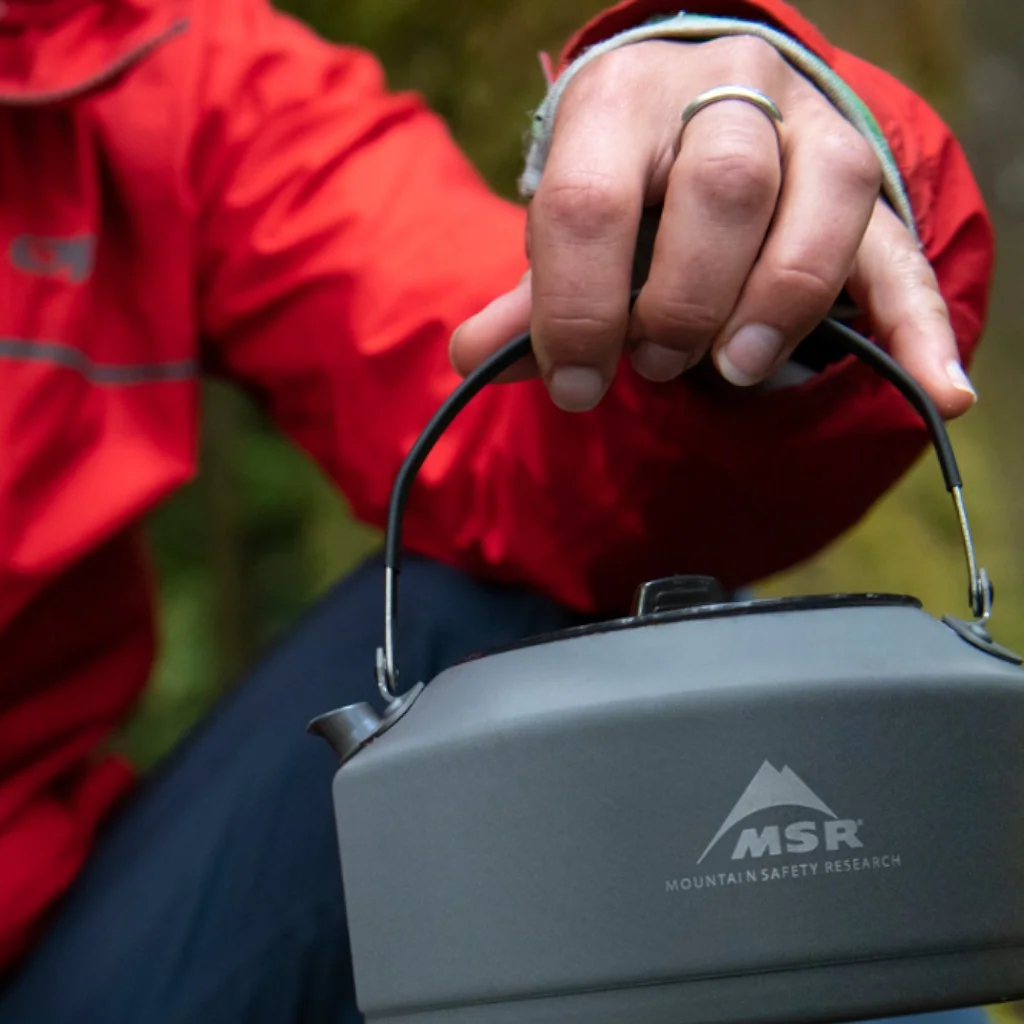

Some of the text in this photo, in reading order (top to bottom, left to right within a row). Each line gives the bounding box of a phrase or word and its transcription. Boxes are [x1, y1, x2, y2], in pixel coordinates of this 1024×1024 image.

[731, 818, 864, 860] MSR
[665, 854, 901, 892] MOUNTAIN SAFETY RESEARCH
